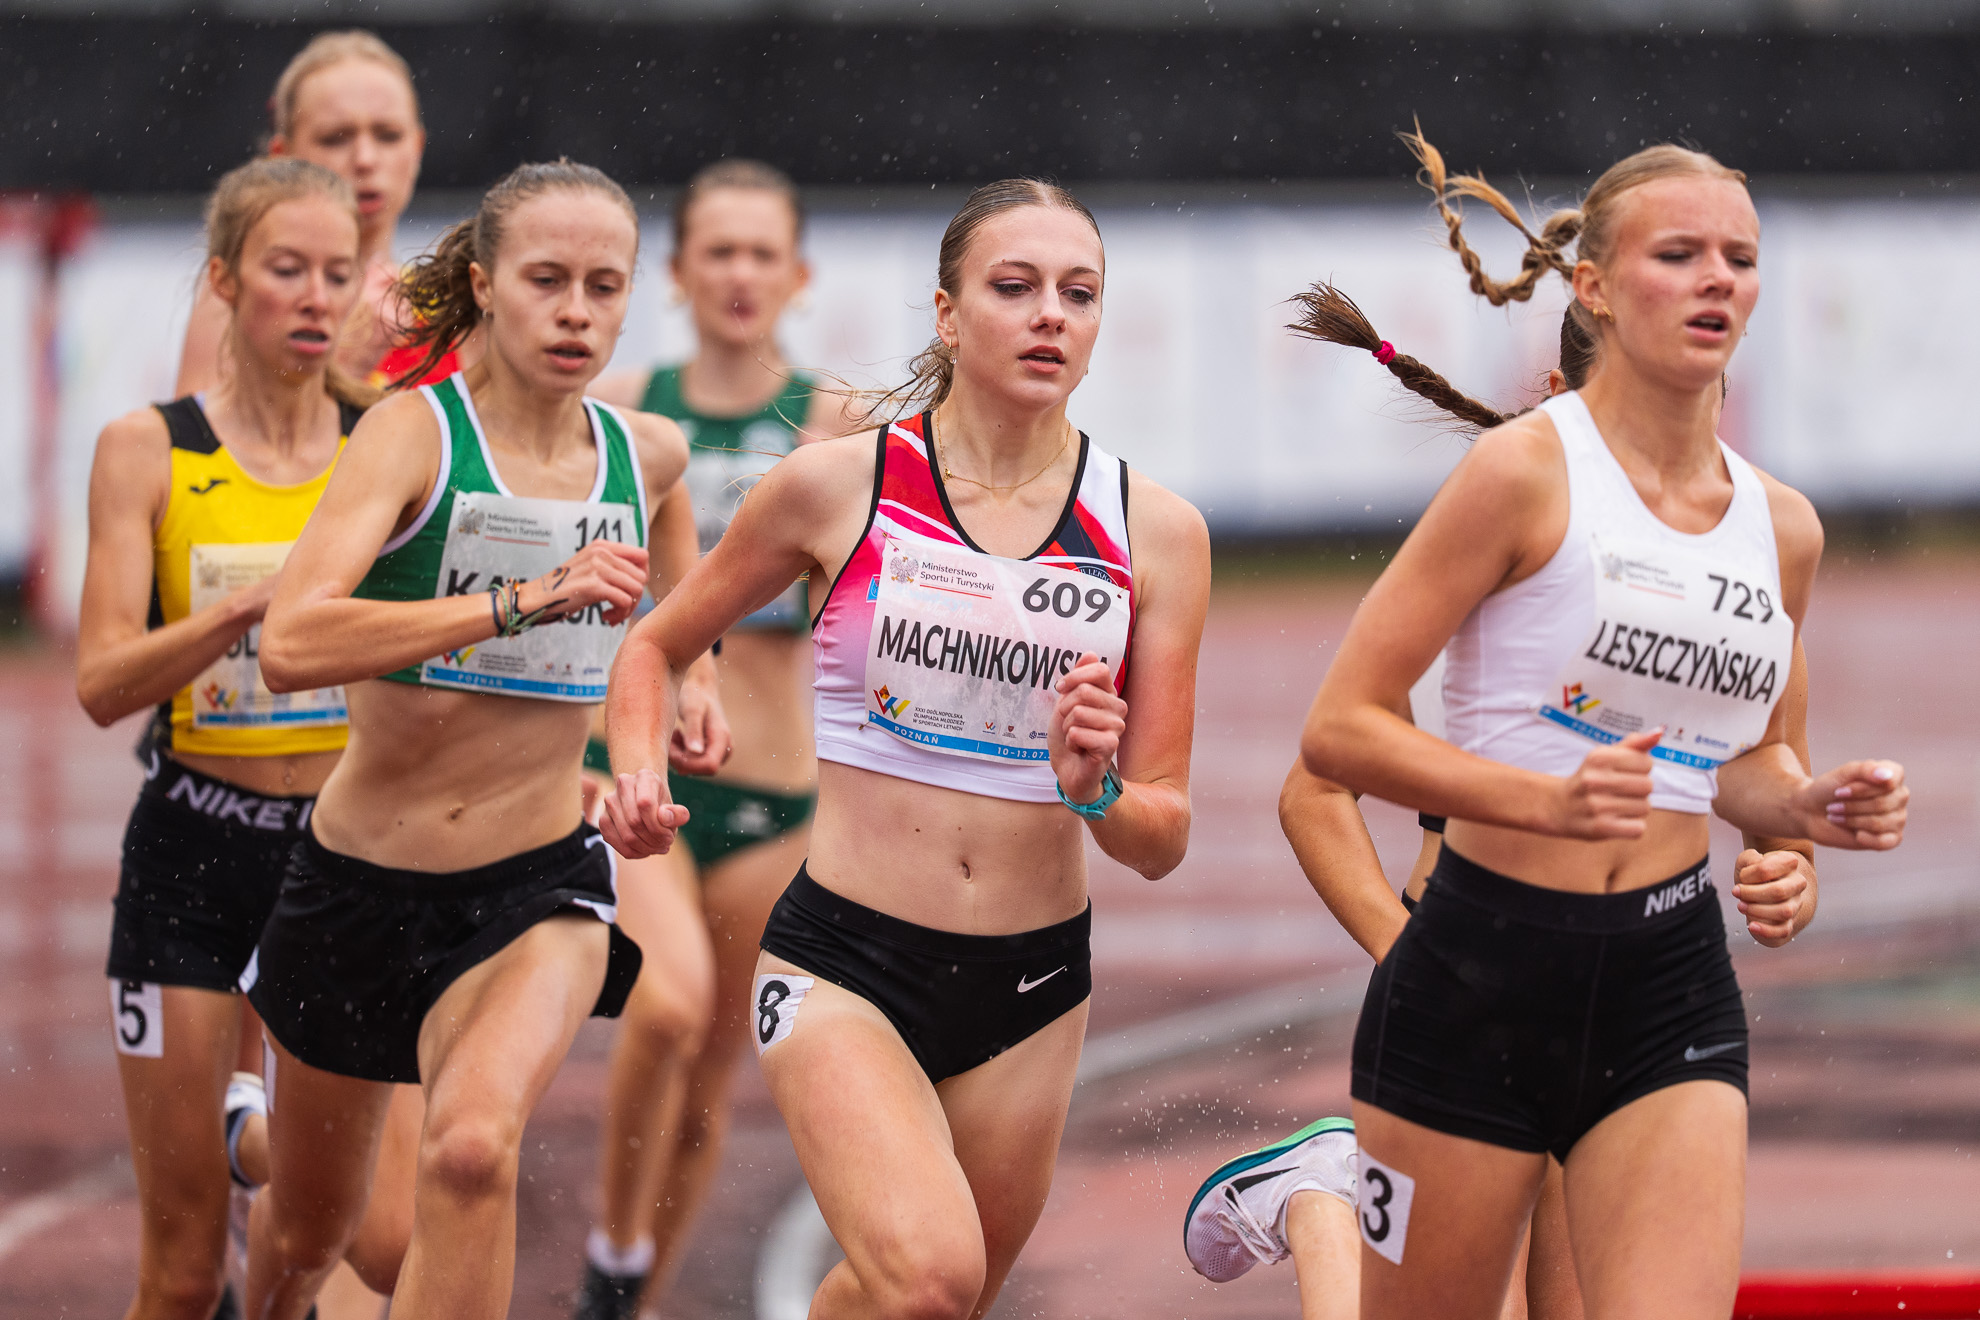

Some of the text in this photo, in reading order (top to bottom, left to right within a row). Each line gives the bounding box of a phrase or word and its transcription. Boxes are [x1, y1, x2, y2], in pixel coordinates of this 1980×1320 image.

[920, 571, 949, 583] Sportu
[956, 577, 995, 591] Turystyki
[921, 561, 978, 578] Ministerstwo
[1022, 577, 1112, 623] 609
[1708, 573, 1774, 624] 729
[877, 615, 1108, 690] MACHNIKOWS
[1585, 620, 1776, 704] LESZCZYŃSKA
[894, 725, 939, 744] POZNAŃ
[913, 713, 940, 722] OLIMPIADA
[918, 719, 943, 728] SPORTACH
[926, 708, 964, 719] OGÓLNOPOLSKA
[997, 747, 1050, 759] 10-13.07.
[168, 773, 294, 831] NIKE
[1644, 874, 1697, 918] NIKE
[118, 979, 147, 1047] 5
[758, 979, 791, 1045] 8
[1363, 1167, 1394, 1243] 3
